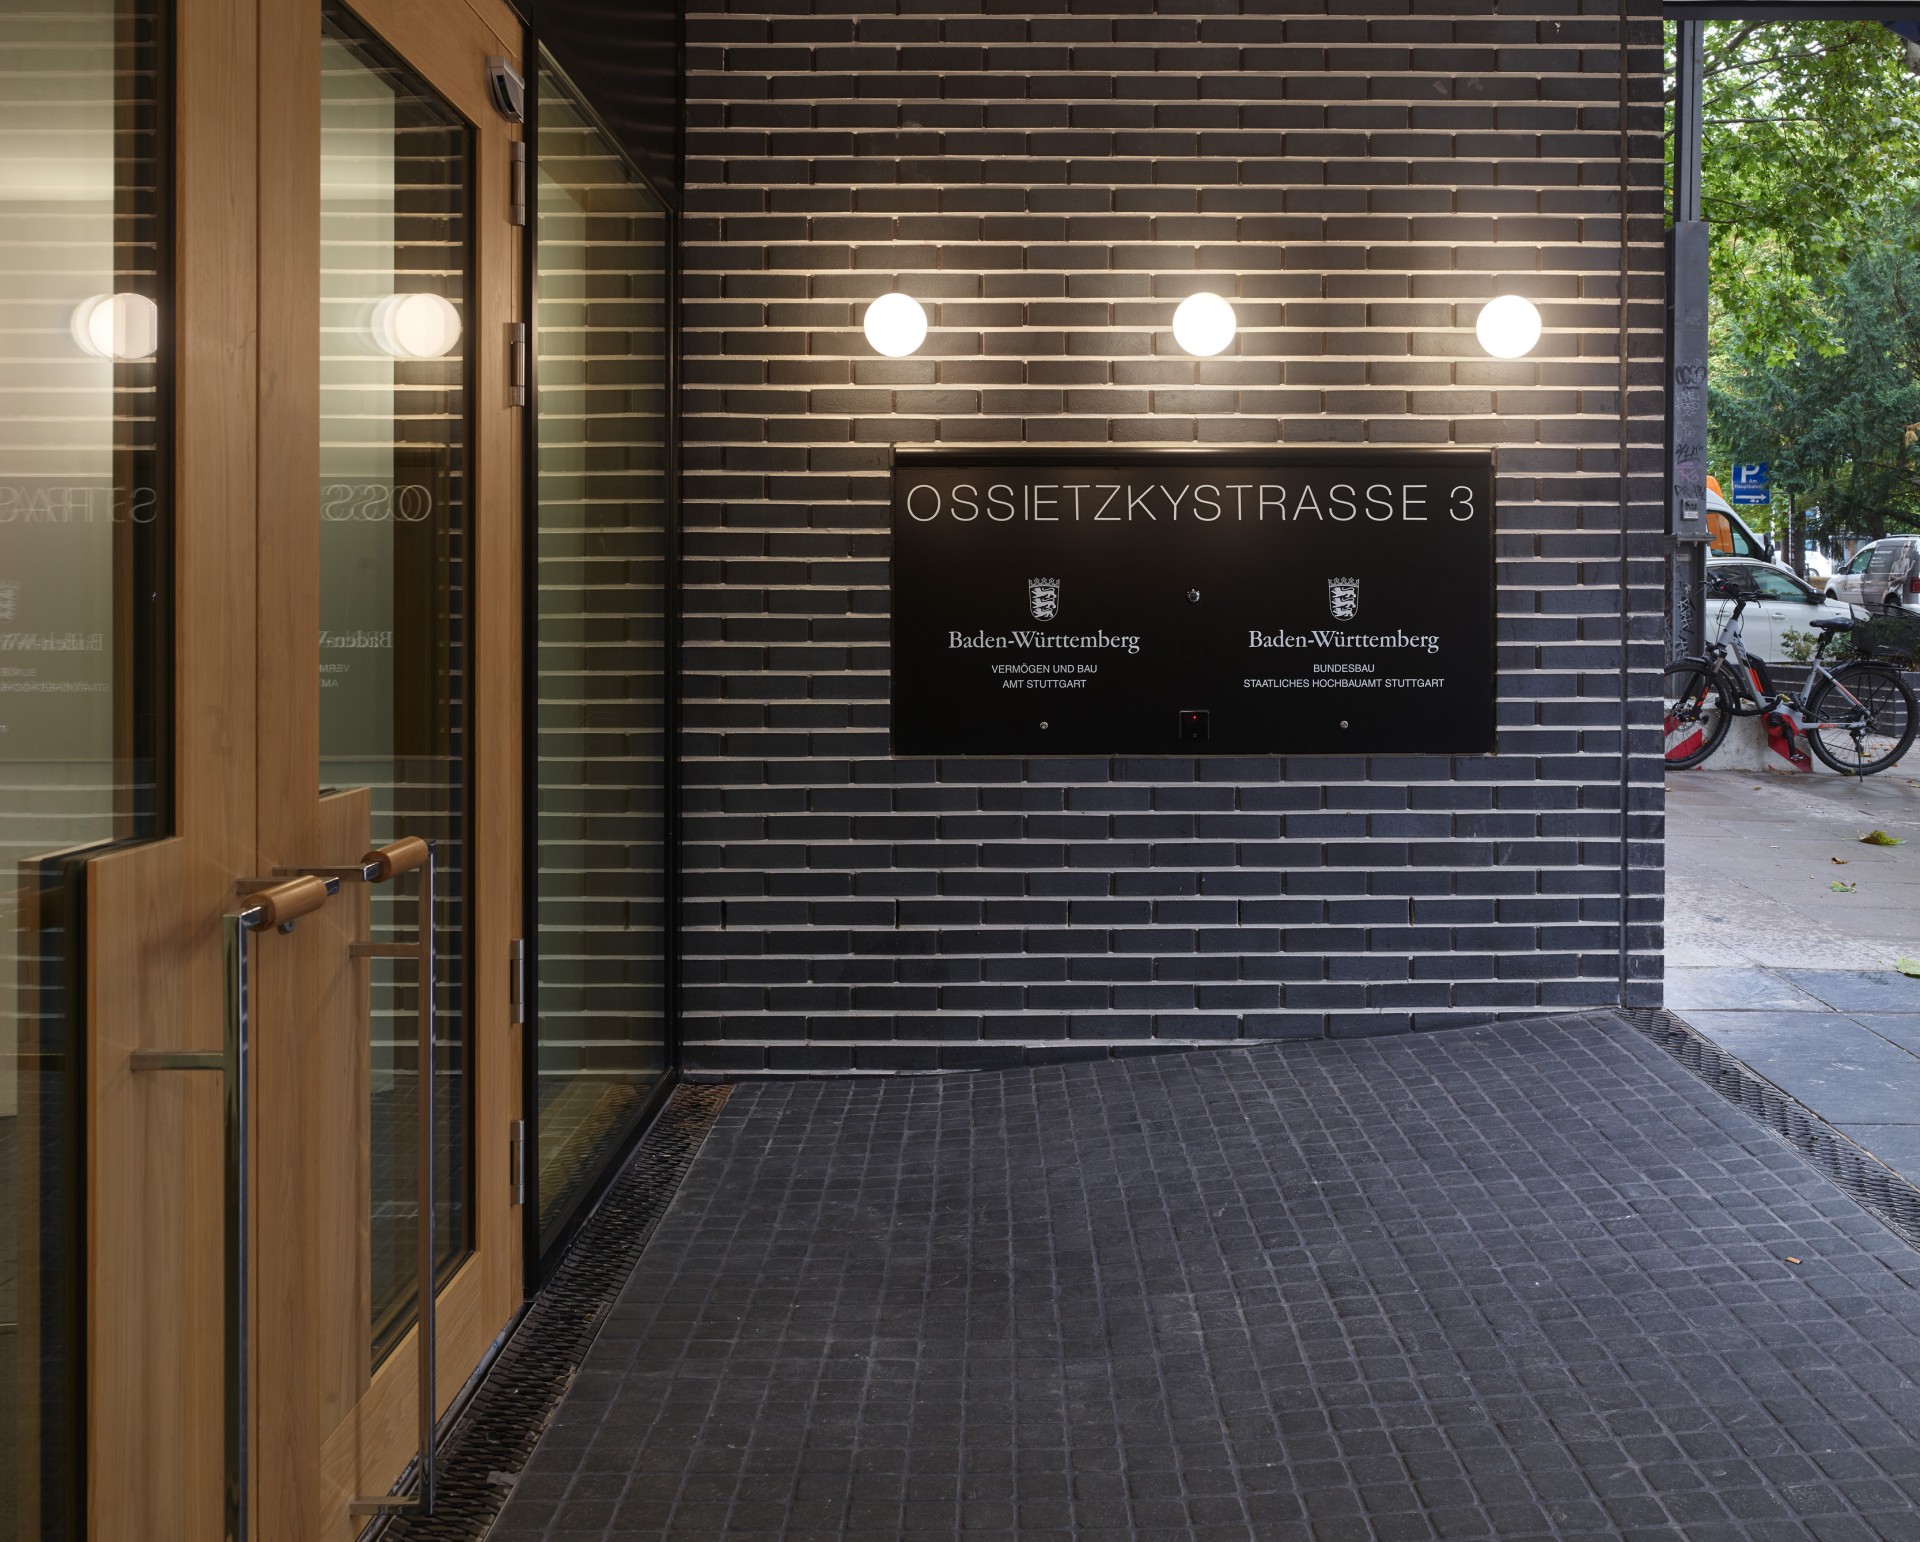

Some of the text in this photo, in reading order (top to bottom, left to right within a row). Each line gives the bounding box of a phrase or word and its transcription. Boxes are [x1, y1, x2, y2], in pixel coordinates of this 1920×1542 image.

[906, 484, 1475, 522] OSSIETZKYSTRASSE 3
[948, 629, 1141, 654] Baden-Württemberg
[1248, 629, 1440, 654] Baden-Württemberg
[991, 662, 1098, 674] VERMÖGEN UND BAU
[1313, 663, 1375, 673] BUNDESBAU
[1002, 679, 1087, 689] AMT STUTTGART
[1243, 678, 1445, 688] STAATLICHES HOCHBAUAMT STUTTGART
